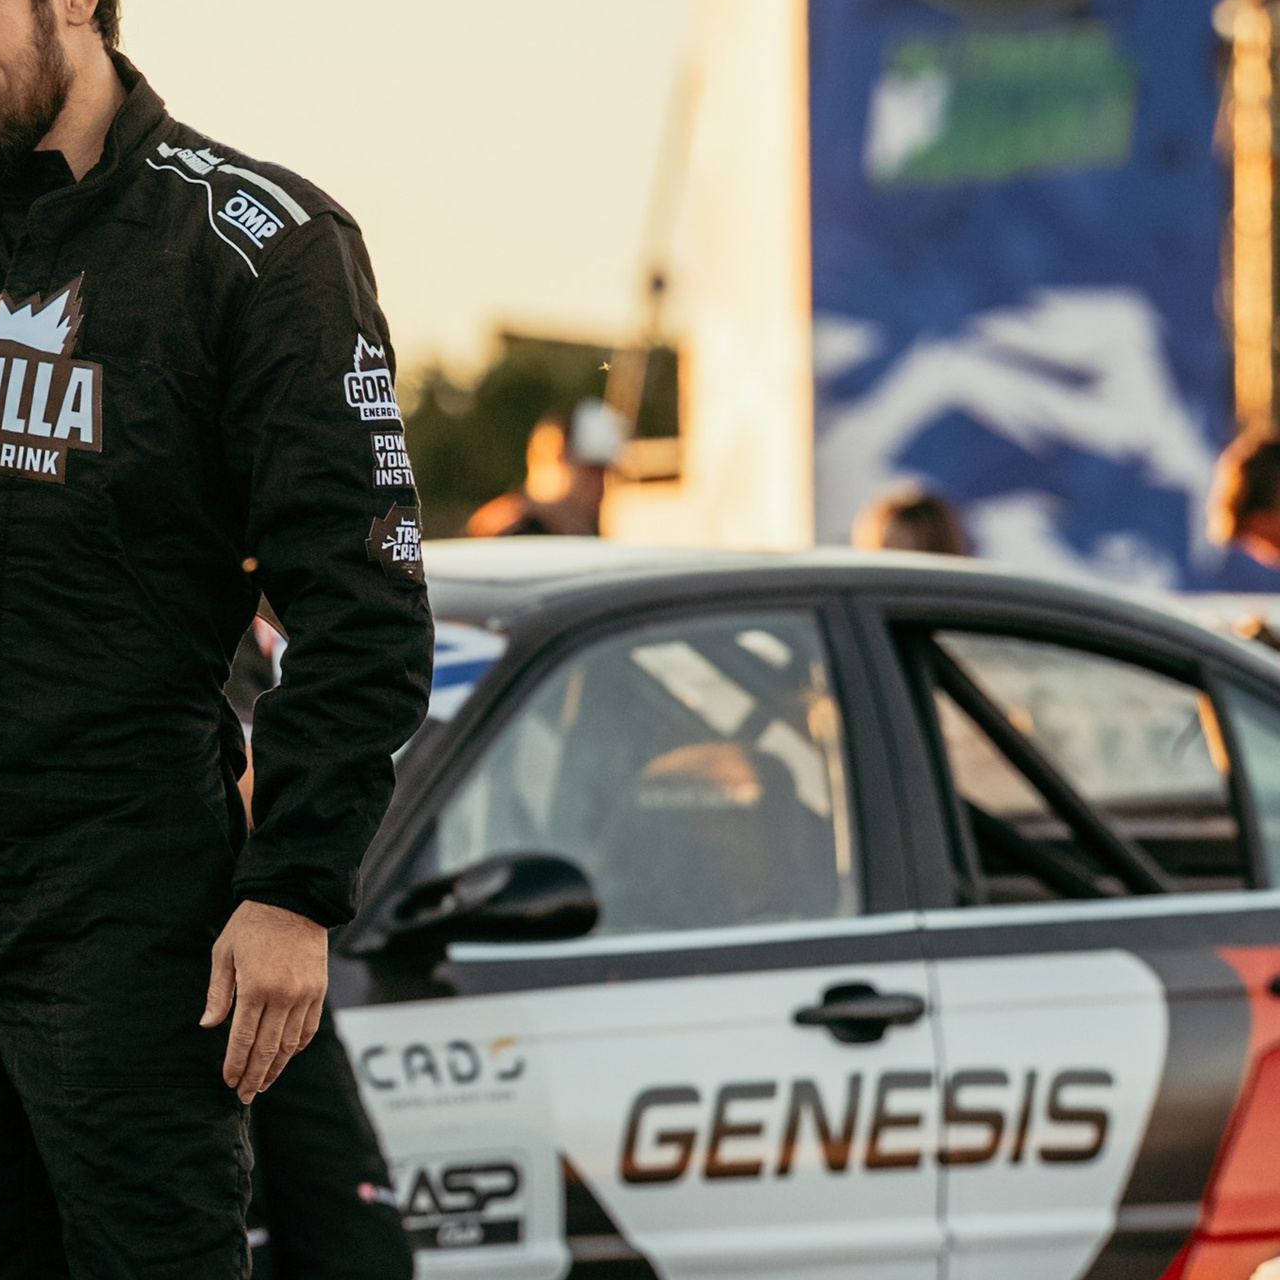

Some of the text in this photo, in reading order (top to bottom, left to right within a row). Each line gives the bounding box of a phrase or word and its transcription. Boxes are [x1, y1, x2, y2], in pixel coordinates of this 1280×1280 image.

[224, 196, 278, 239] OMP
[363, 407, 396, 418] ENERGY
[620, 1069, 1114, 1183] GENESIS
